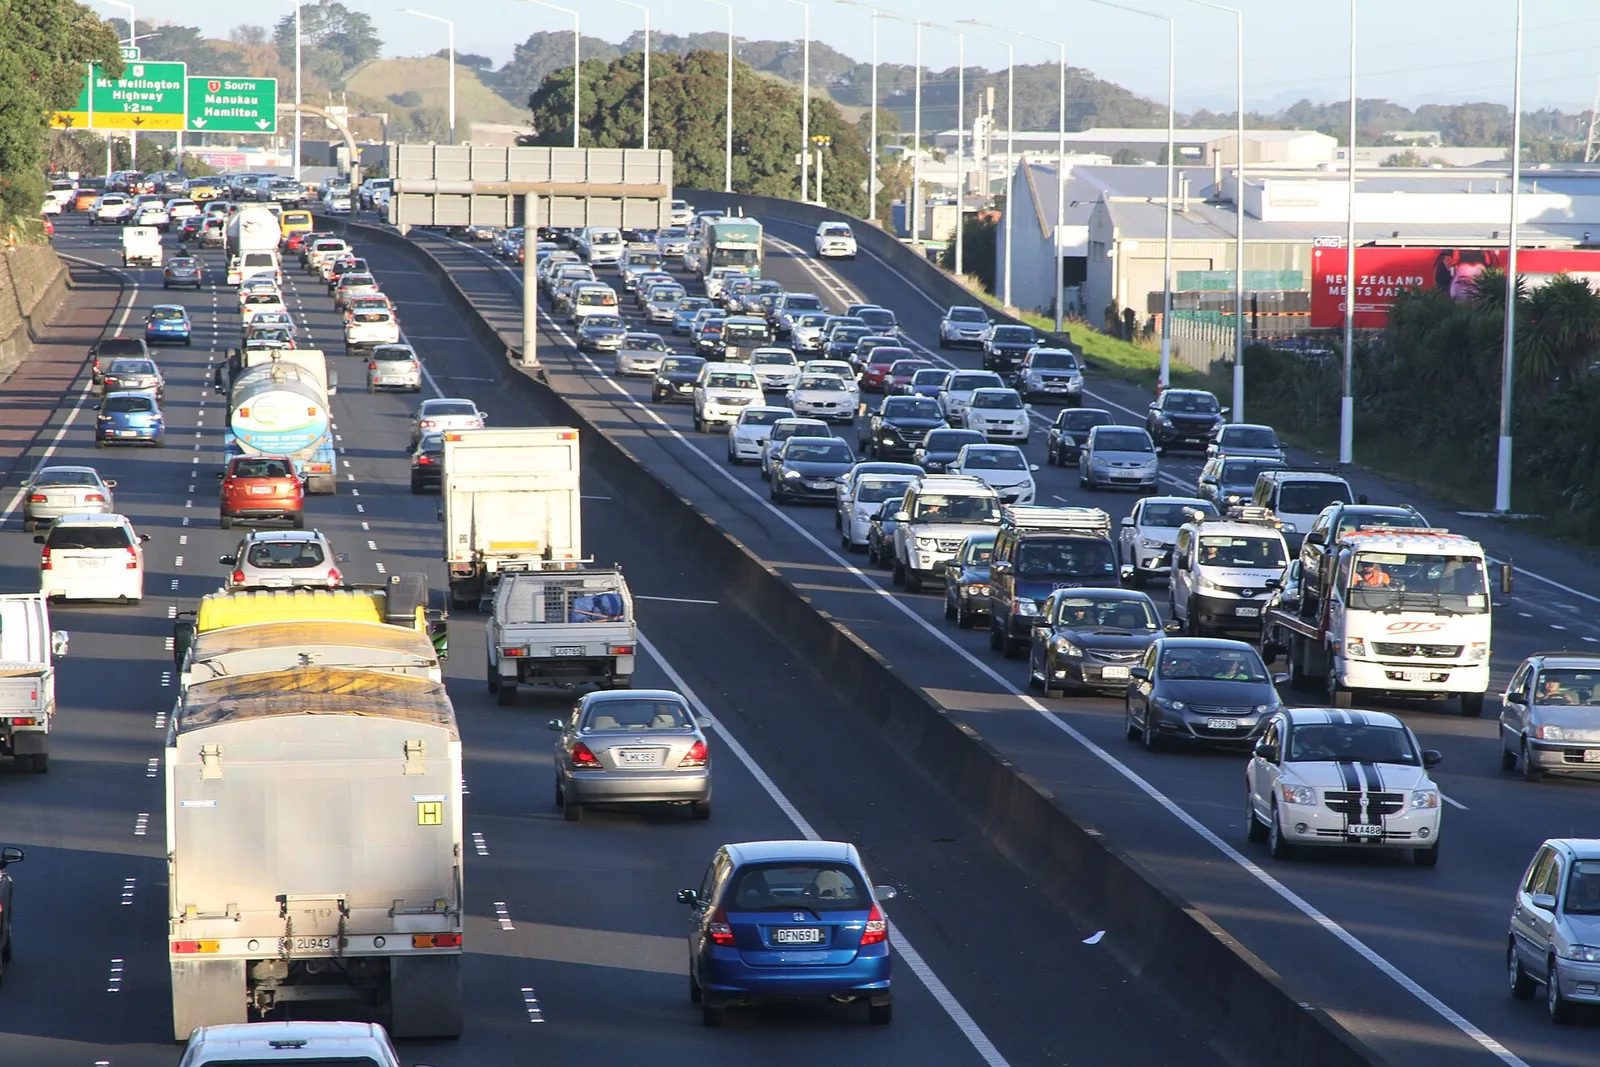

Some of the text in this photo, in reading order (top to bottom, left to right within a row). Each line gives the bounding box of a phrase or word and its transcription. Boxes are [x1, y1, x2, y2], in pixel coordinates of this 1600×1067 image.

[96, 78, 180, 91] Mt Wellington
[112, 90, 163, 103] Highway
[204, 94, 258, 105] Manukau
[204, 106, 258, 118] Hamilton
[1360, 275, 1424, 286] ZEALAND
[1328, 286, 1372, 296] METS
[1386, 622, 1446, 631] OTS
[423, 803, 437, 823] H
[778, 929, 819, 942] DFN691
[297, 938, 331, 949] 2U943
